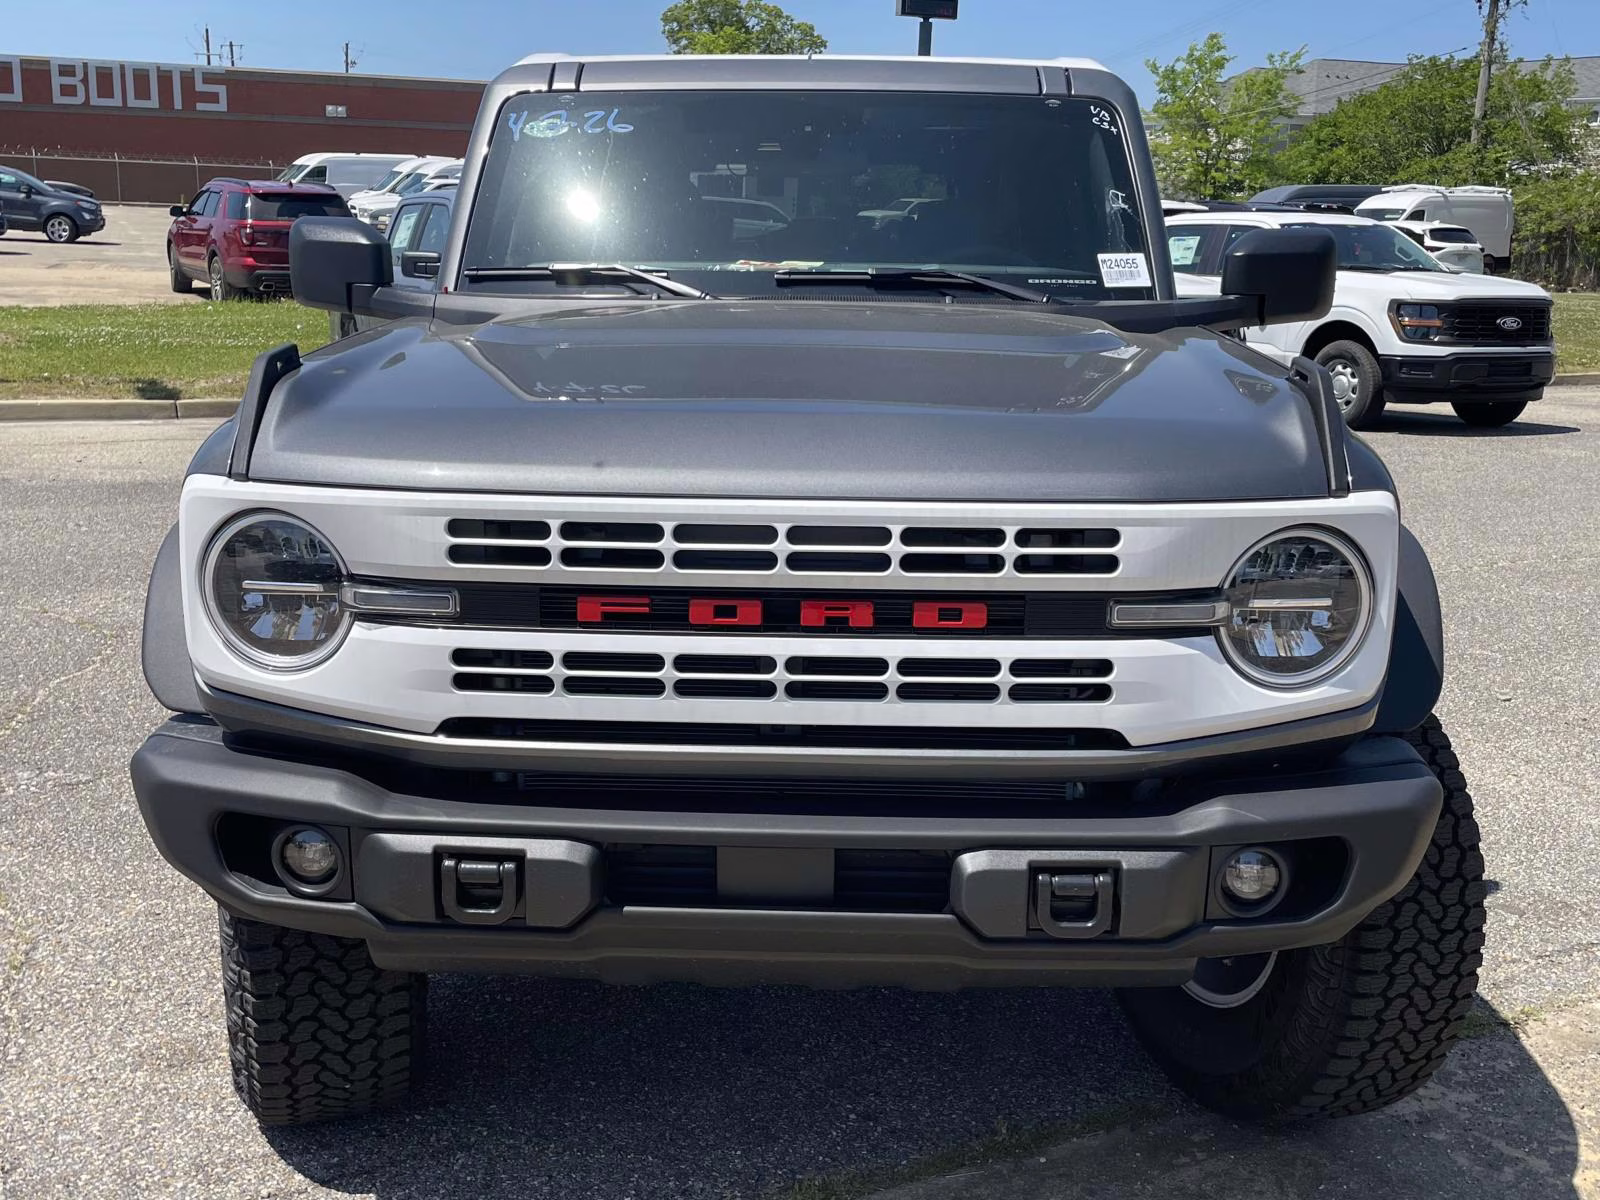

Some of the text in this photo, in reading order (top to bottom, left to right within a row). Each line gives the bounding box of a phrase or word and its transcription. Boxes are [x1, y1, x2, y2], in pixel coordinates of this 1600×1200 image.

[50, 56, 228, 112] BOOTS
[1100, 258, 1139, 270] M24055
[576, 596, 988, 628] FORD
